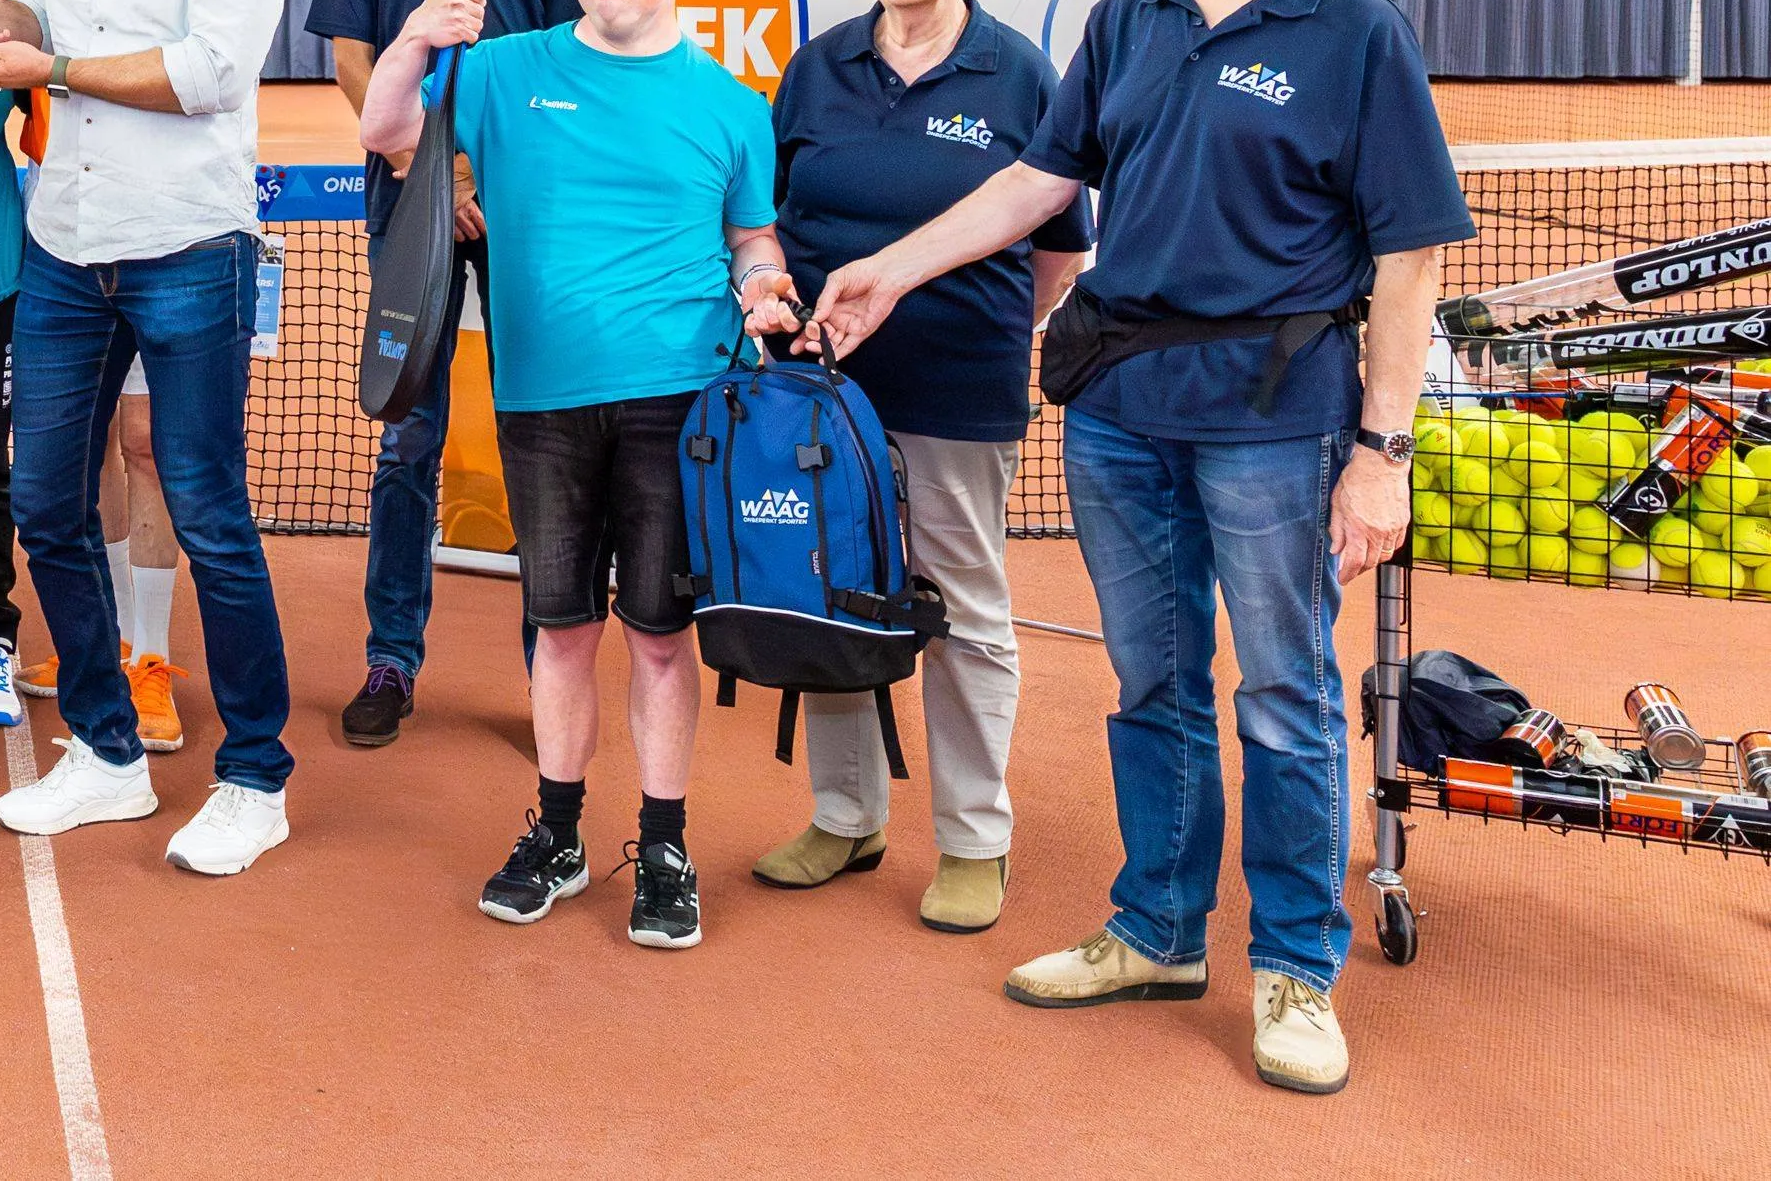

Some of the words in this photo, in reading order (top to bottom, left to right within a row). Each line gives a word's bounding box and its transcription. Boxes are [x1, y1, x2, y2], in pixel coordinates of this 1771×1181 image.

[1219, 65, 1296, 100] WAAG
[927, 117, 994, 144] WAAG
[257, 179, 282, 202] 45
[1561, 322, 1731, 358] DUNLOP
[740, 500, 810, 518] WAAG
